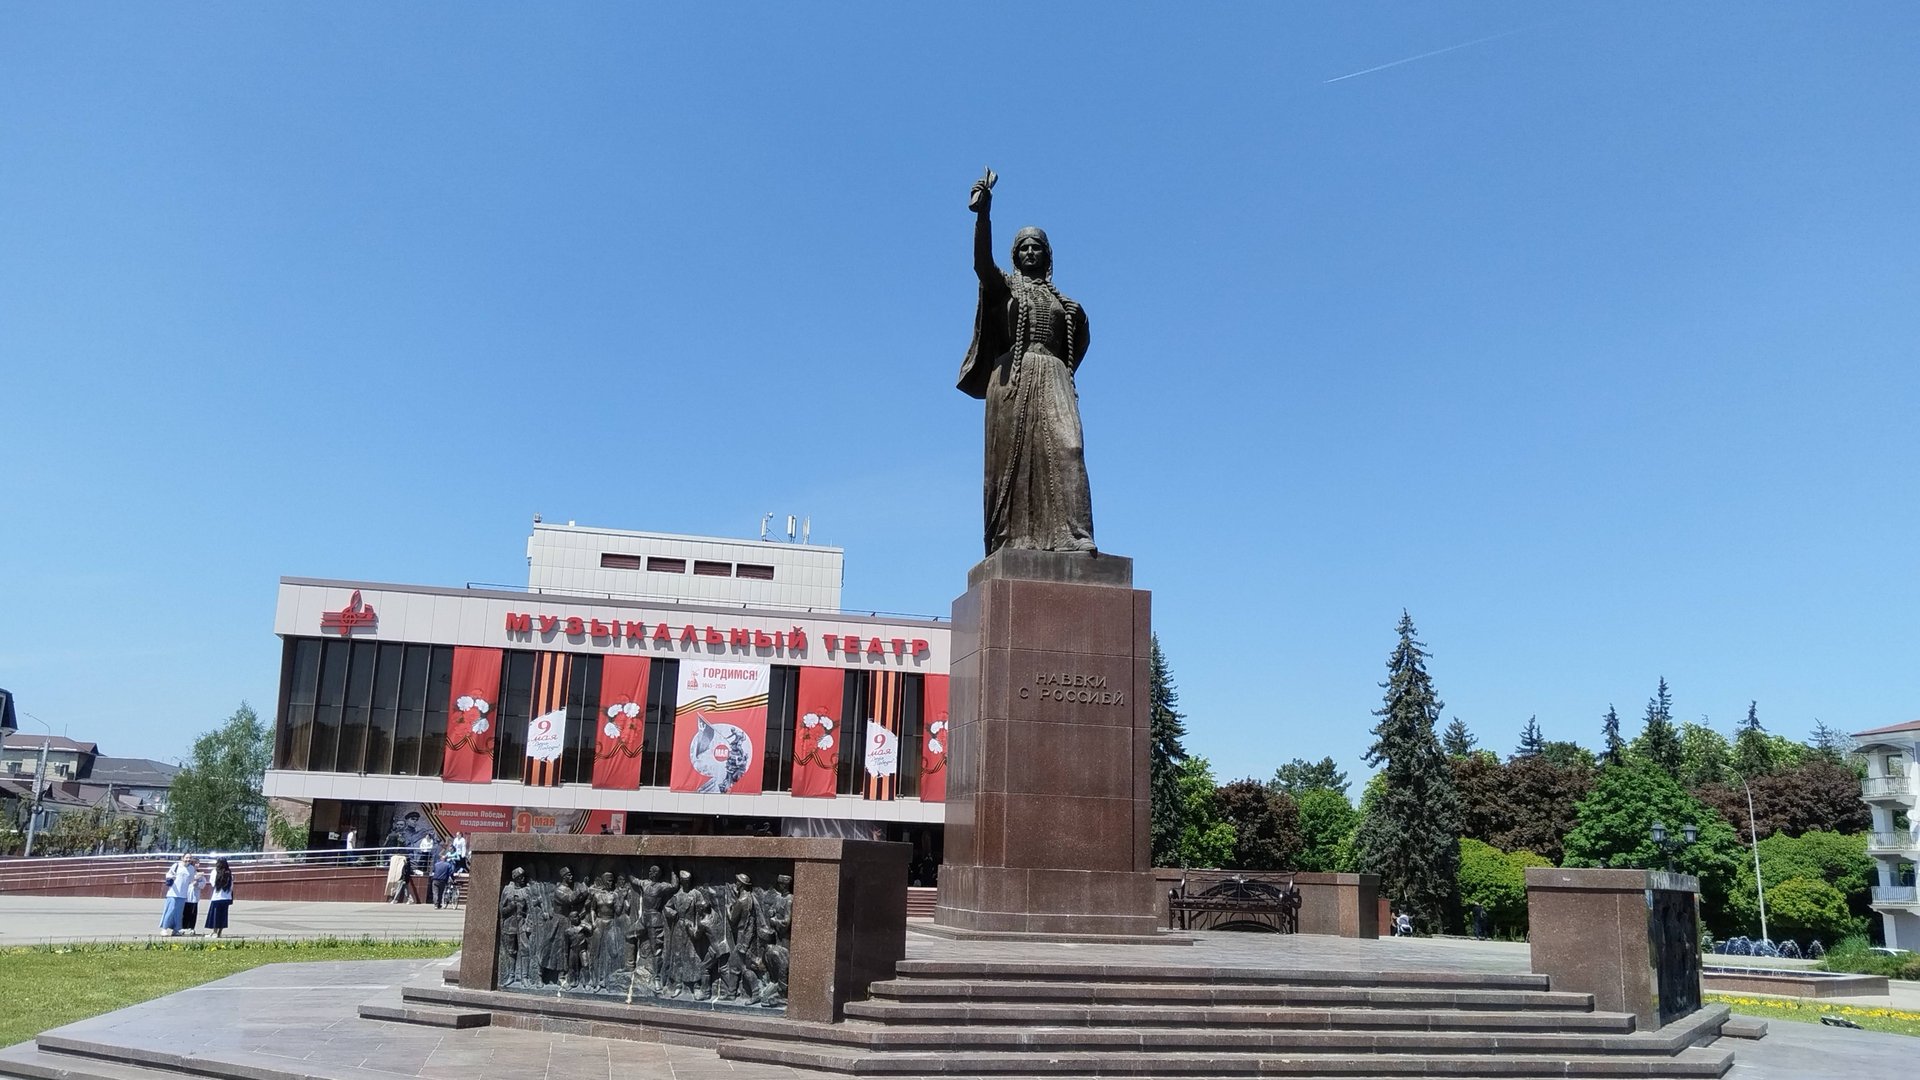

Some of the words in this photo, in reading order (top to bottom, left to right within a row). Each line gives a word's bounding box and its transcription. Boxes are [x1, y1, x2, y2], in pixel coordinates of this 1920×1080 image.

[506, 613, 806, 650] МУЗЫКАЛЬНЫЙ
[823, 634, 929, 656] ТЕАТР
[703, 667, 758, 681] ГОРДИМСЯ!
[1036, 673, 1107, 689] НАВЕКИ
[1018, 687, 1029, 699] С
[1039, 688, 1124, 706] РОССИЕЙ
[537, 720, 551, 736] 9
[873, 733, 887, 750] 9
[867, 748, 892, 757] мая
[438, 809, 479, 819] праздником
[480, 810, 506, 819] Победы
[516, 811, 533, 833] 9
[534, 815, 555, 828] мая
[460, 819, 504, 828] поздравляем
